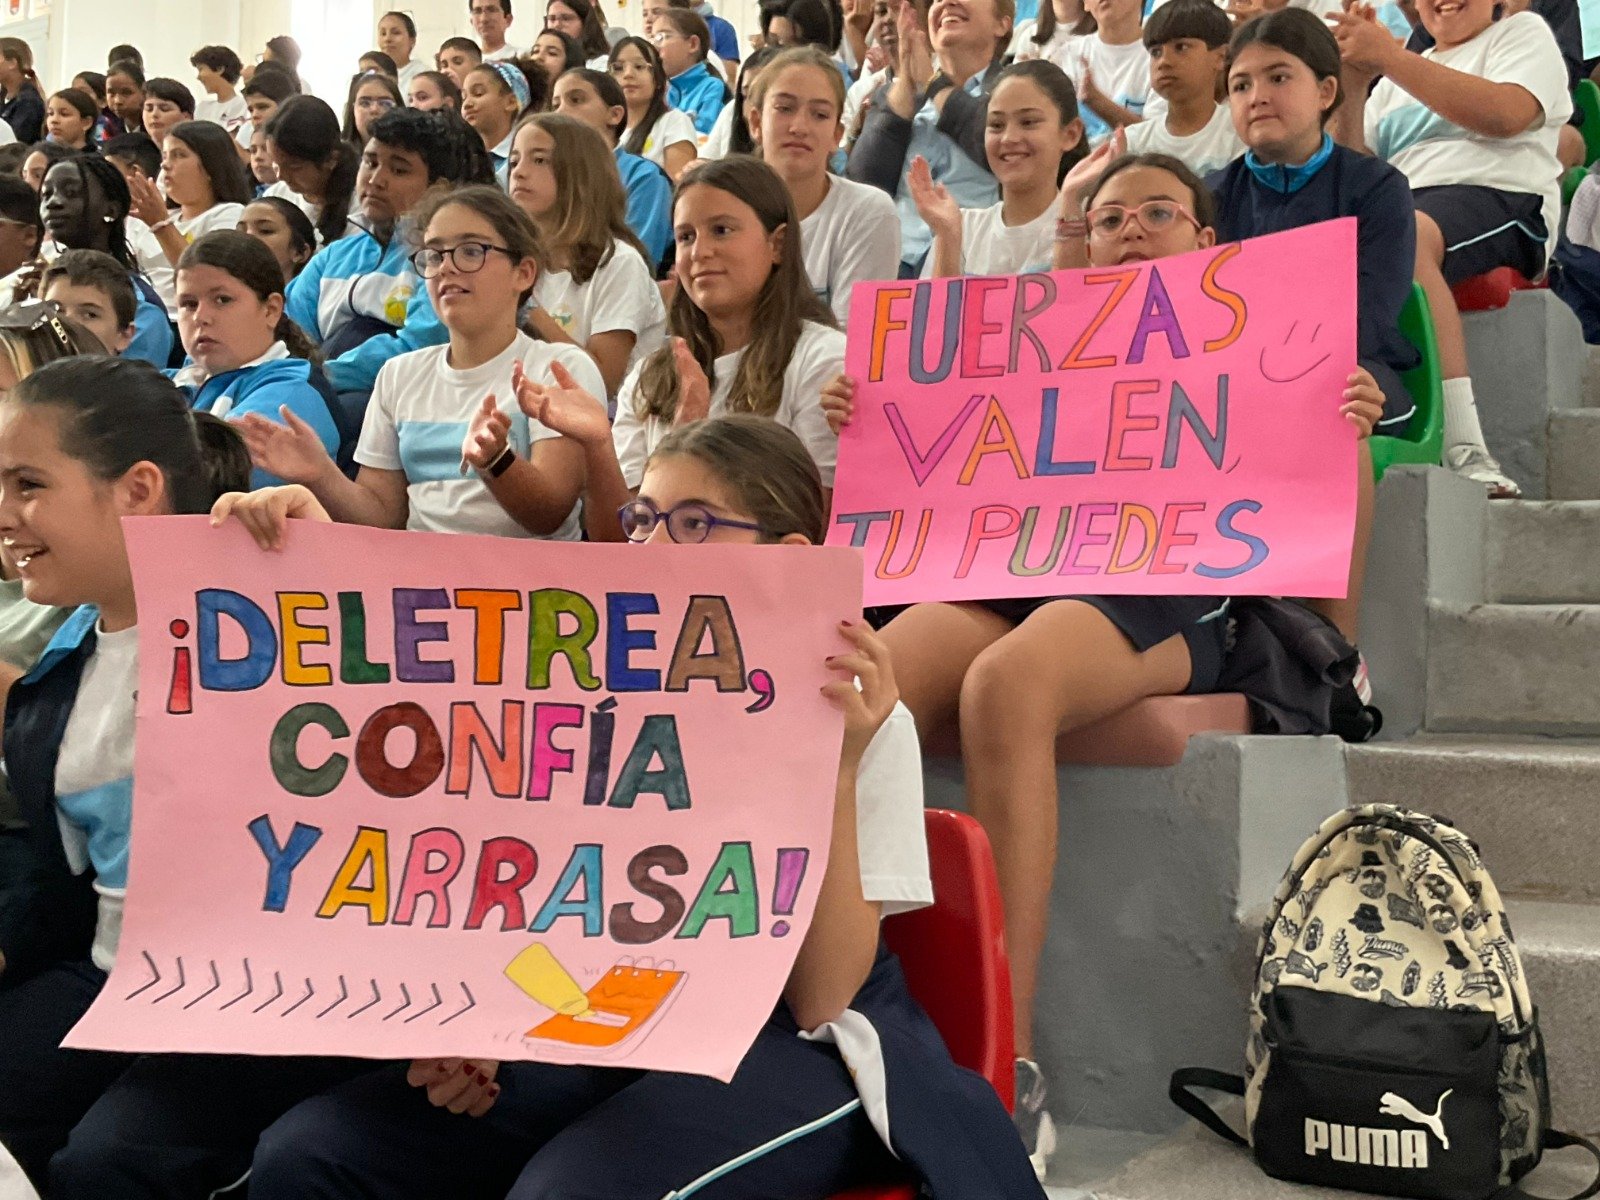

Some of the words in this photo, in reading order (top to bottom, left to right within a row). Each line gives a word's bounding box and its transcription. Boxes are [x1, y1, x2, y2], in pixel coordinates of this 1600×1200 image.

[867, 243, 1248, 385] FUERZAS
[836, 508, 931, 580] TU
[953, 498, 1270, 580] PUEDES
[165, 587, 776, 715] ¡DELETREA,
[269, 695, 692, 811] CONFÍA
[315, 825, 810, 945] ARRASA!
[1304, 1117, 1428, 1168] PUMA
